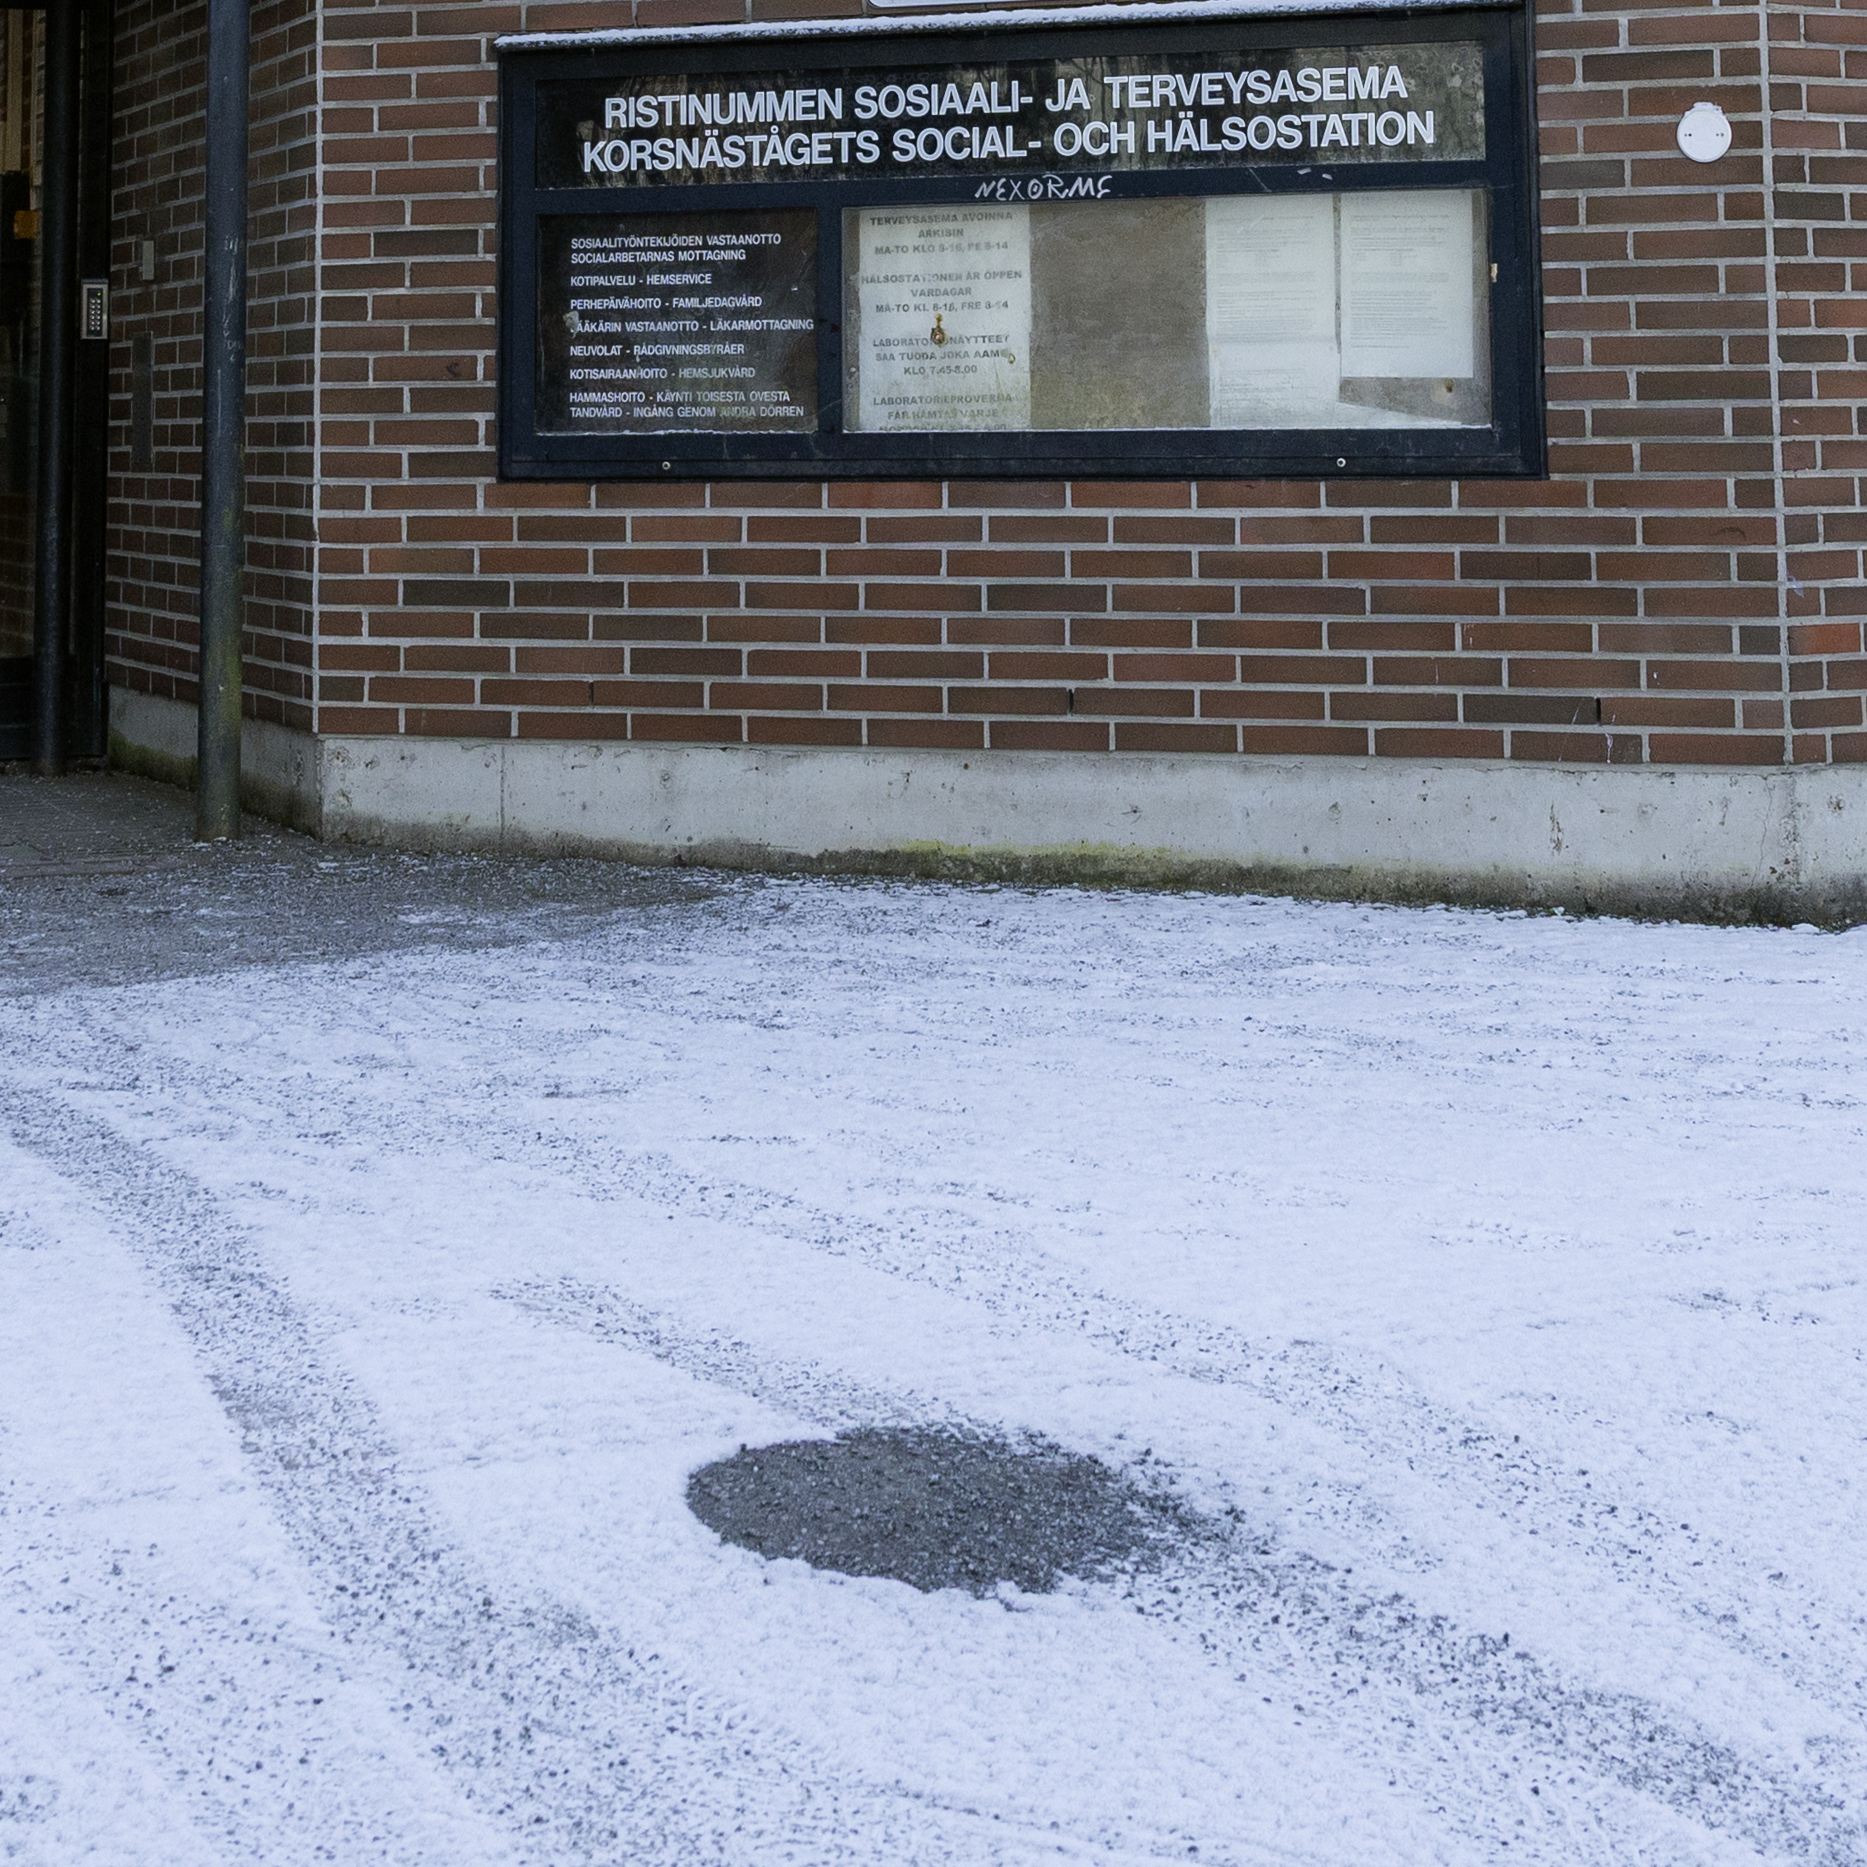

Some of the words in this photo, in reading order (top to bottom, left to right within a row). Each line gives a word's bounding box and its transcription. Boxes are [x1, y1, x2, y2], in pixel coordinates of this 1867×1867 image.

[604, 87, 843, 129] RISTINUMMEN
[854, 80, 1033, 120] SOSIAALI-
[1045, 77, 1091, 112] JA
[1104, 65, 1409, 109] TERVEYSASEMA
[583, 125, 880, 173] KORSNÄSTÅGETS
[891, 125, 1042, 163] SOCIAL-
[1053, 120, 1136, 157] OCH
[1146, 110, 1436, 153] HÄLSOSTATION
[870, 213, 959, 226] TERVEYSASEMA
[962, 212, 1013, 223] AVOINNA
[917, 228, 965, 239] ARKISIN
[571, 234, 703, 250] SOSIAALITYÖNTEKIJÖIDEN
[706, 233, 782, 246] VASTAANOTTO
[571, 250, 675, 264] SOCIALARBETARNAS
[678, 249, 747, 261] MOTTAGNING
[570, 275, 636, 287] KOTIPALVELU
[646, 273, 712, 285] HEMSERVICE
[910, 286, 972, 298] VARDAGAR
[570, 296, 661, 310] PERHEPÄIVÄHOITO
[672, 294, 762, 308] FAMILJEDAGVÅRD
[571, 320, 622, 333] ÄÄKÄRIN
[625, 320, 699, 332] VASTAANOTTO
[710, 318, 814, 331] LÄKARMOTTAGNING
[570, 345, 623, 356] NEUVOLAT
[633, 341, 745, 356] RÅDGIVNINGSBYRÅER
[876, 352, 895, 362] SAA
[940, 350, 971, 360] JOKA
[569, 368, 668, 380] KOTISAIRAANHOITO
[678, 365, 756, 379] HEMSJUKVÅRD
[569, 391, 645, 403] HAMMASHOITO
[656, 389, 693, 402] KÄYNTI
[696, 391, 746, 402] TOISESTA
[749, 390, 790, 402] OVESTA
[570, 404, 622, 417] TANDVÅRD
[633, 404, 674, 417] INGÅNG
[677, 406, 716, 418] GENOM
[719, 406, 756, 417] ANDRA
[759, 404, 804, 417] DÖRREN
